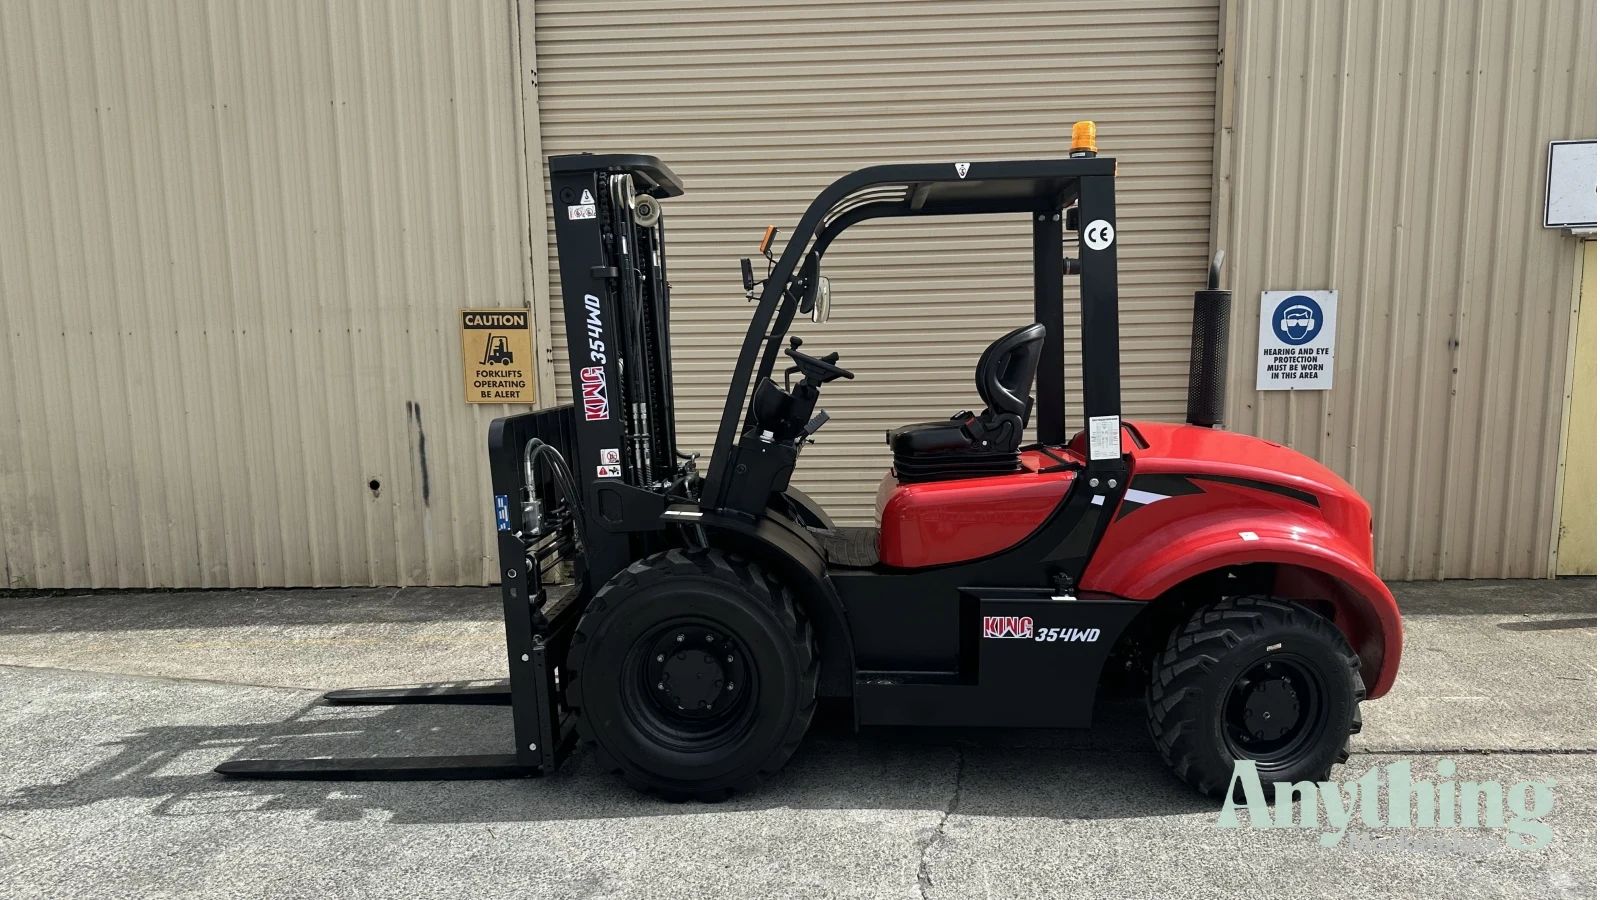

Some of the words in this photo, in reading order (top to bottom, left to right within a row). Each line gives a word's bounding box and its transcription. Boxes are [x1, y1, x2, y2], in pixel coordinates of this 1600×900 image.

[1088, 226, 1109, 243] CE
[465, 314, 525, 326] CAUTION
[584, 293, 607, 365] 354WD
[1263, 348, 1296, 356] HEARING
[1298, 348, 1314, 356] AND
[1316, 347, 1330, 355] EYE
[1273, 356, 1318, 364] PROTECTION
[1266, 364, 1287, 372] MUST
[1301, 363, 1324, 371] WORN
[476, 370, 522, 378] FORKLIFTS
[1299, 371, 1319, 379] AREA
[473, 380, 526, 388] OPERATING
[580, 366, 609, 421] KING
[983, 616, 1034, 639] KING
[1035, 627, 1101, 642] 354WD
